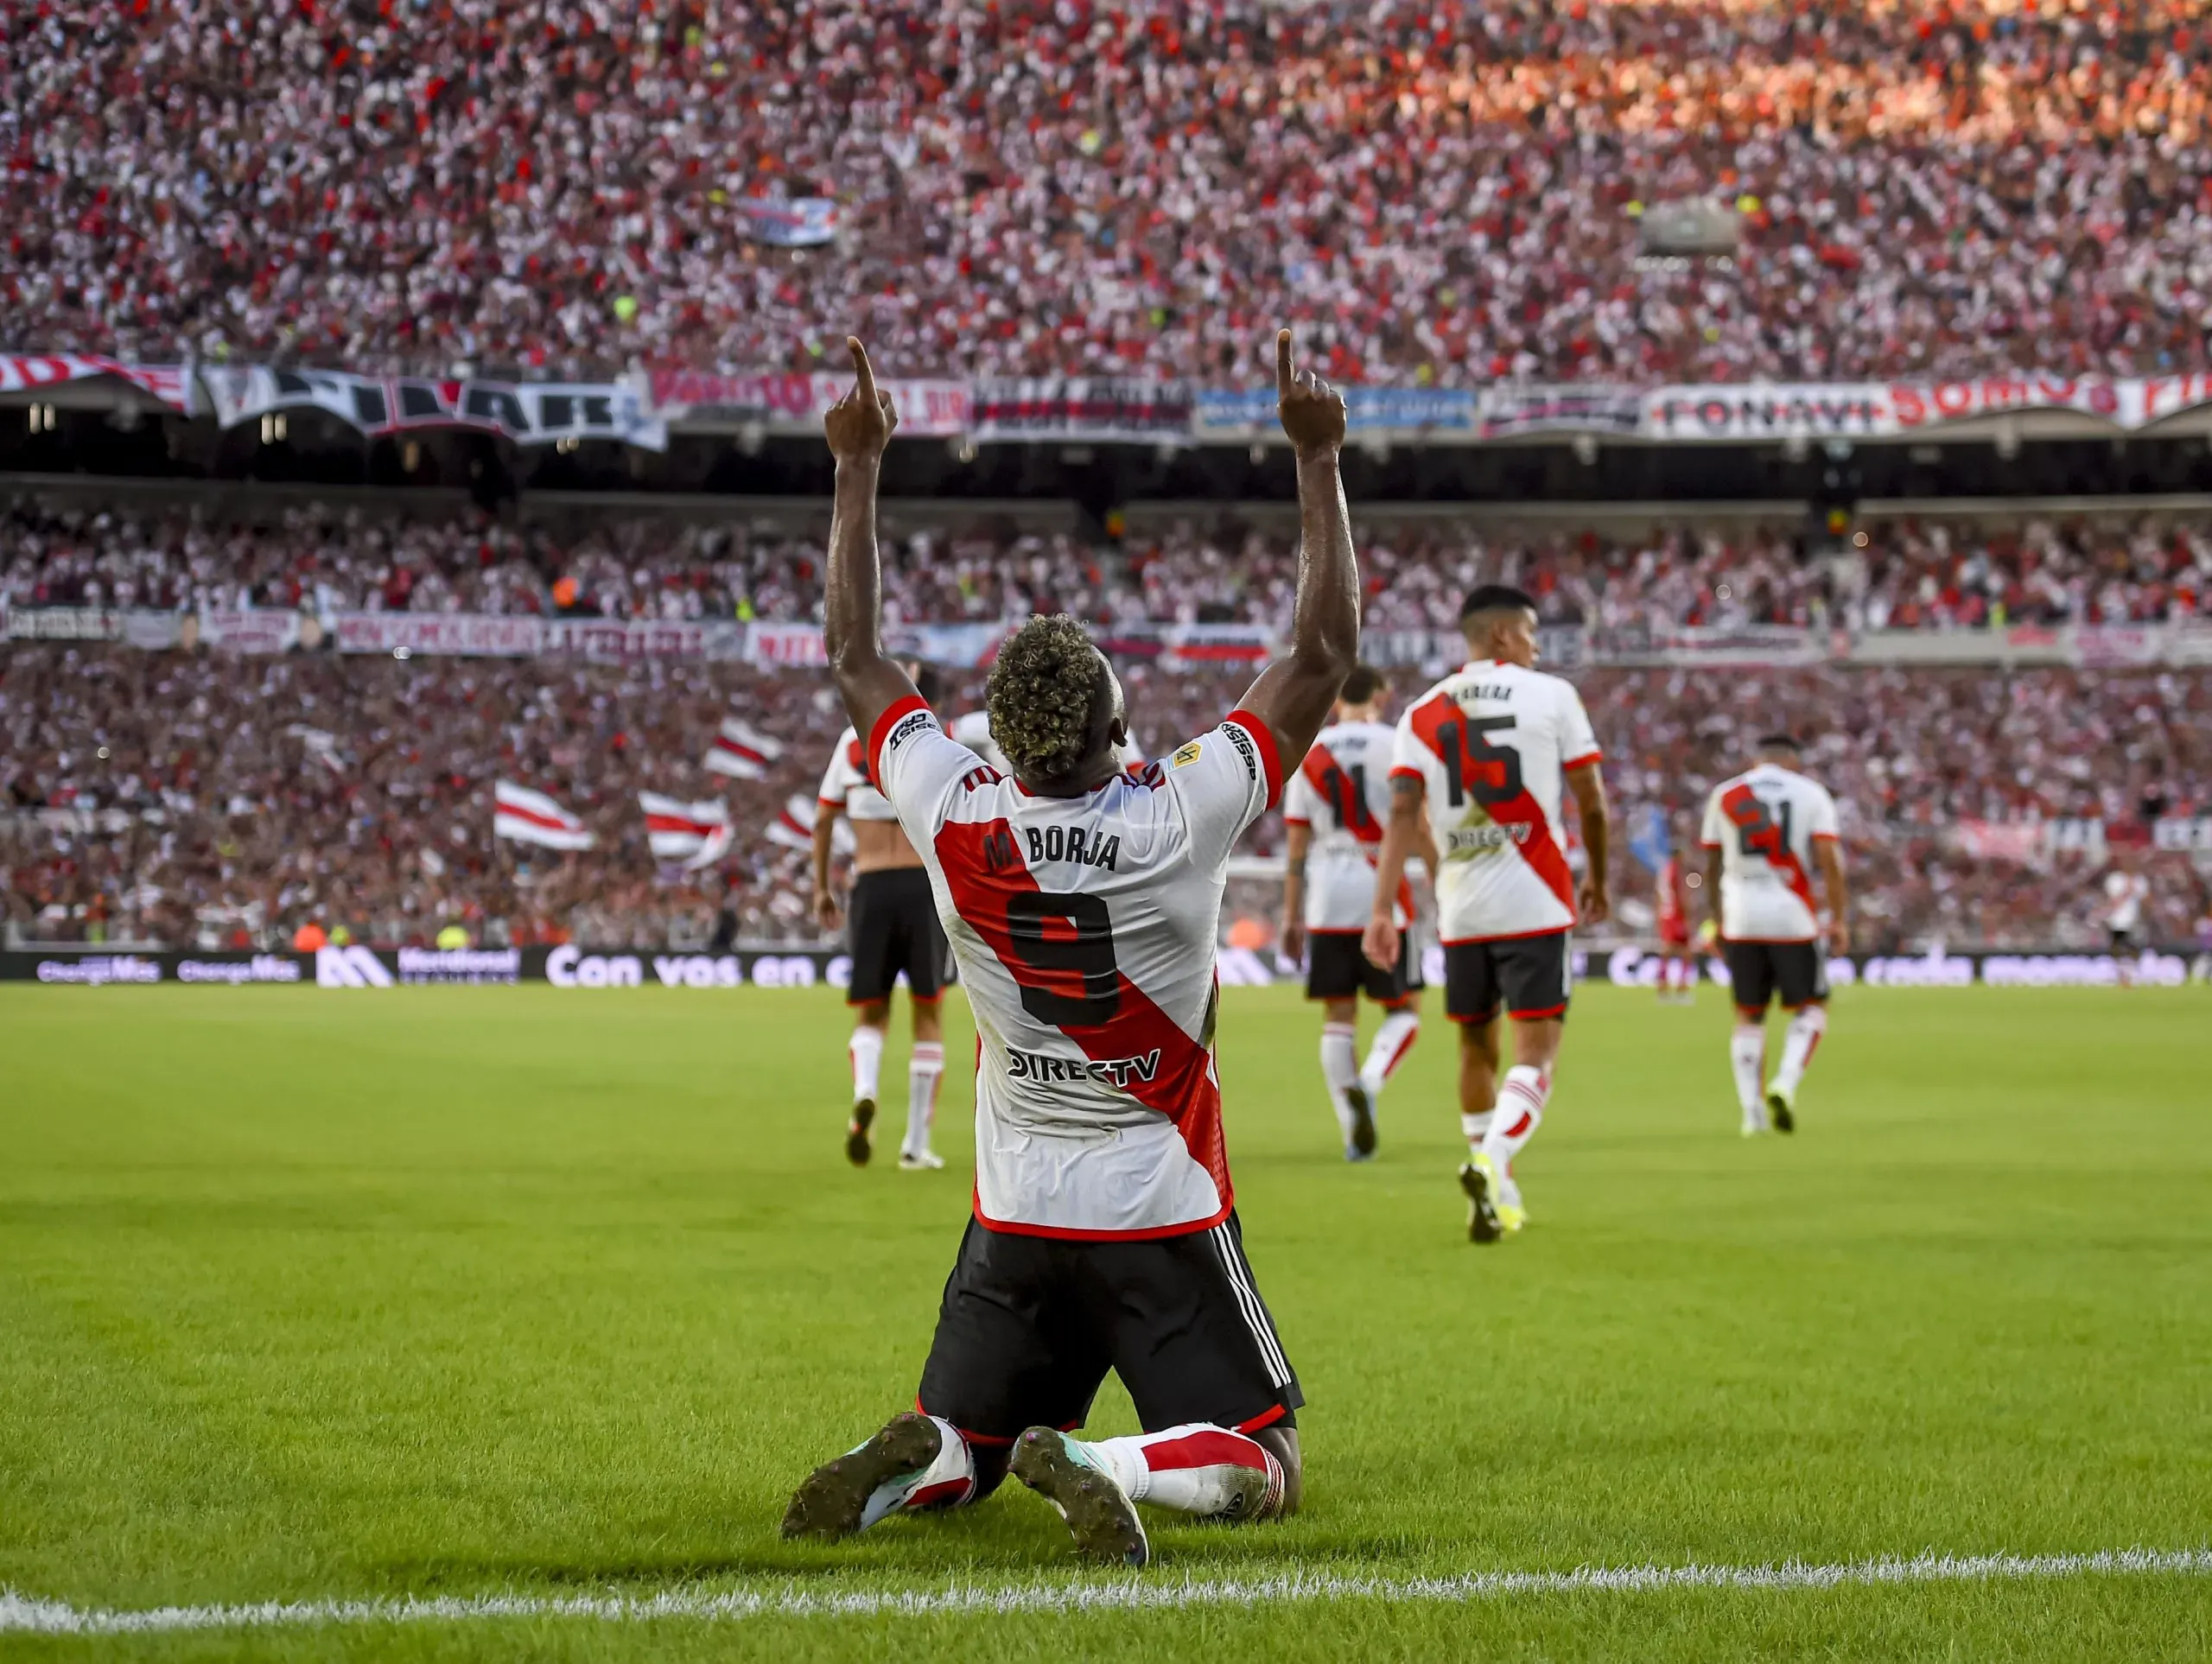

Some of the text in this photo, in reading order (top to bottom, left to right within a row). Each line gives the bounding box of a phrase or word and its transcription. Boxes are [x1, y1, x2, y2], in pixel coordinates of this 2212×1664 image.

[1437, 715, 1522, 808] 15
[1323, 764, 1368, 830] 11
[1026, 825, 1121, 872] BORJA
[1736, 799, 1792, 855] 21
[545, 944, 643, 988] Con
[652, 955, 743, 988] vos
[751, 955, 816, 987] en
[1007, 892, 1121, 1026] 9
[1004, 1046, 1161, 1088] DIRECTV
